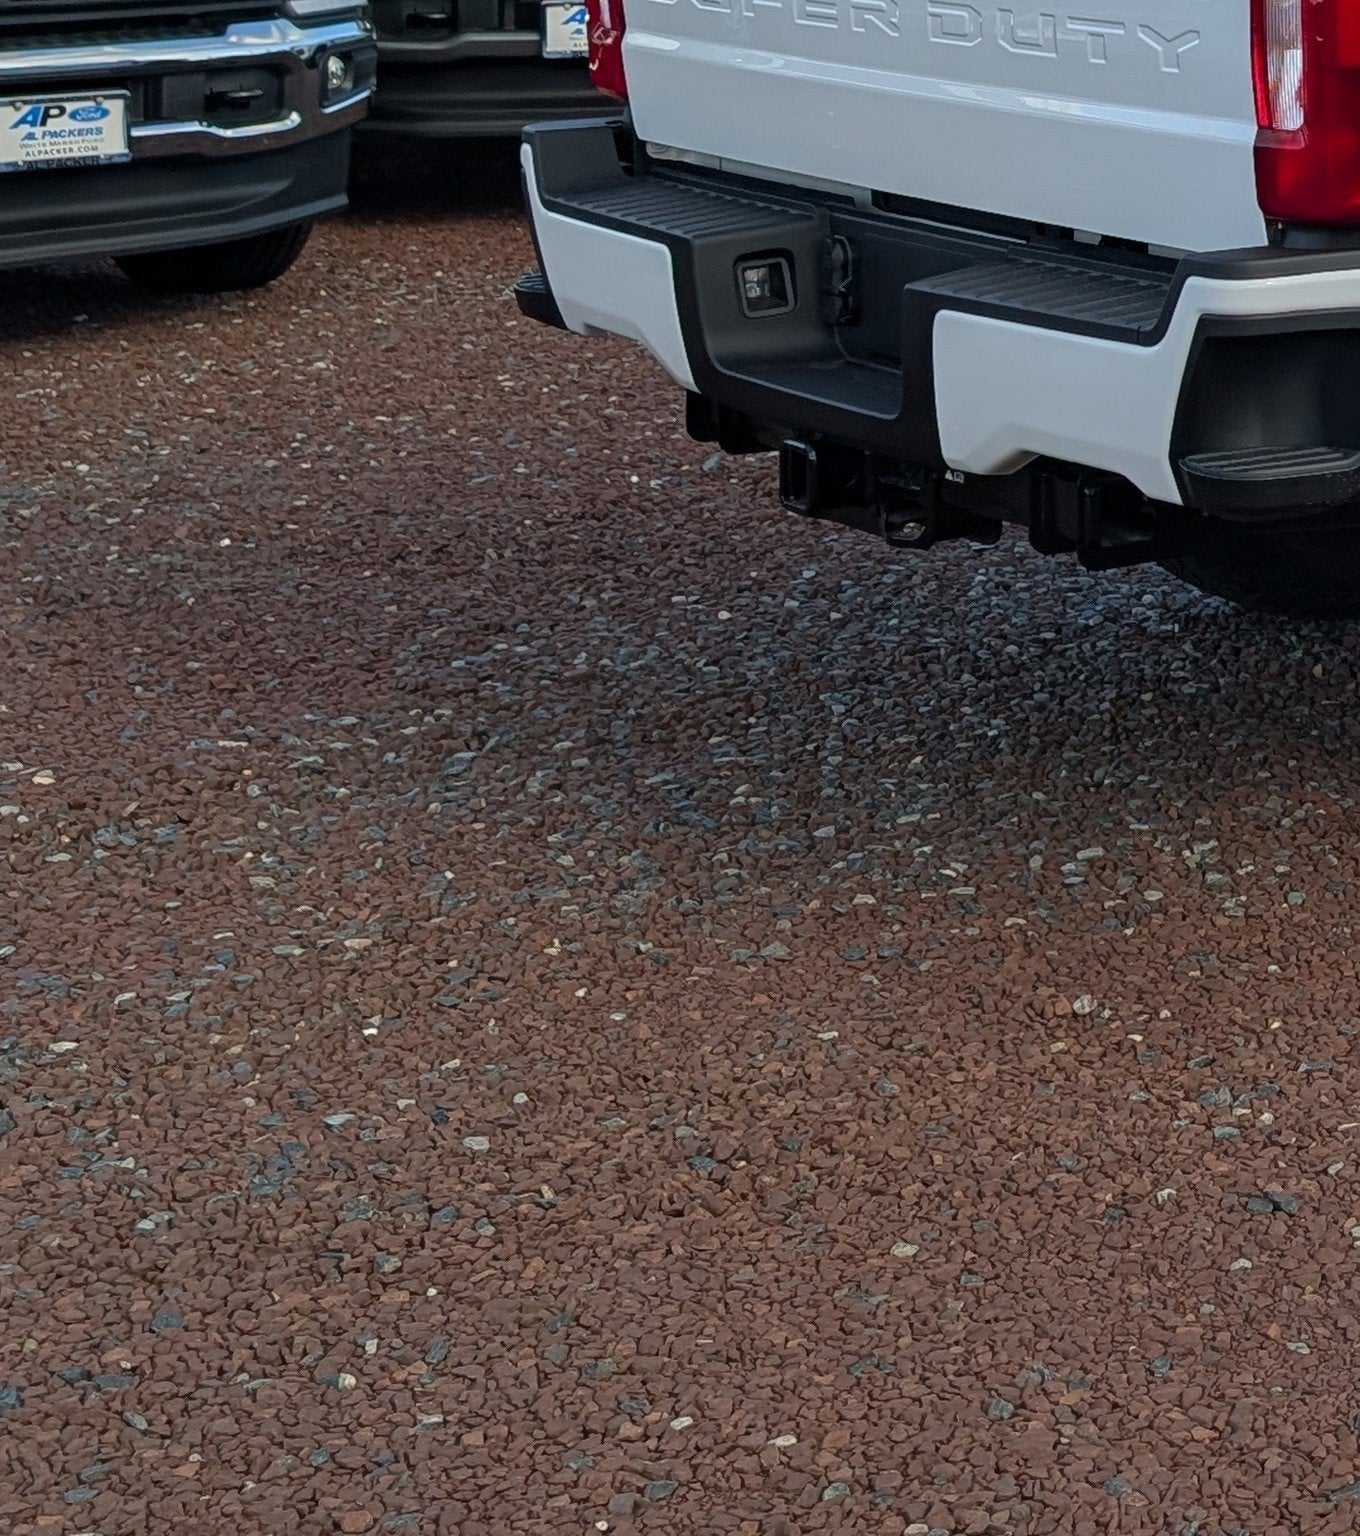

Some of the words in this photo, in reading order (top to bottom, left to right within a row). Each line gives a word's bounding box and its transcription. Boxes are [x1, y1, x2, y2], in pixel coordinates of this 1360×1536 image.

[926, 0, 1201, 73] DUTY
[9, 104, 67, 129] AP
[42, 126, 104, 139] PACKERS
[25, 145, 98, 158] ALPACKER.COM
